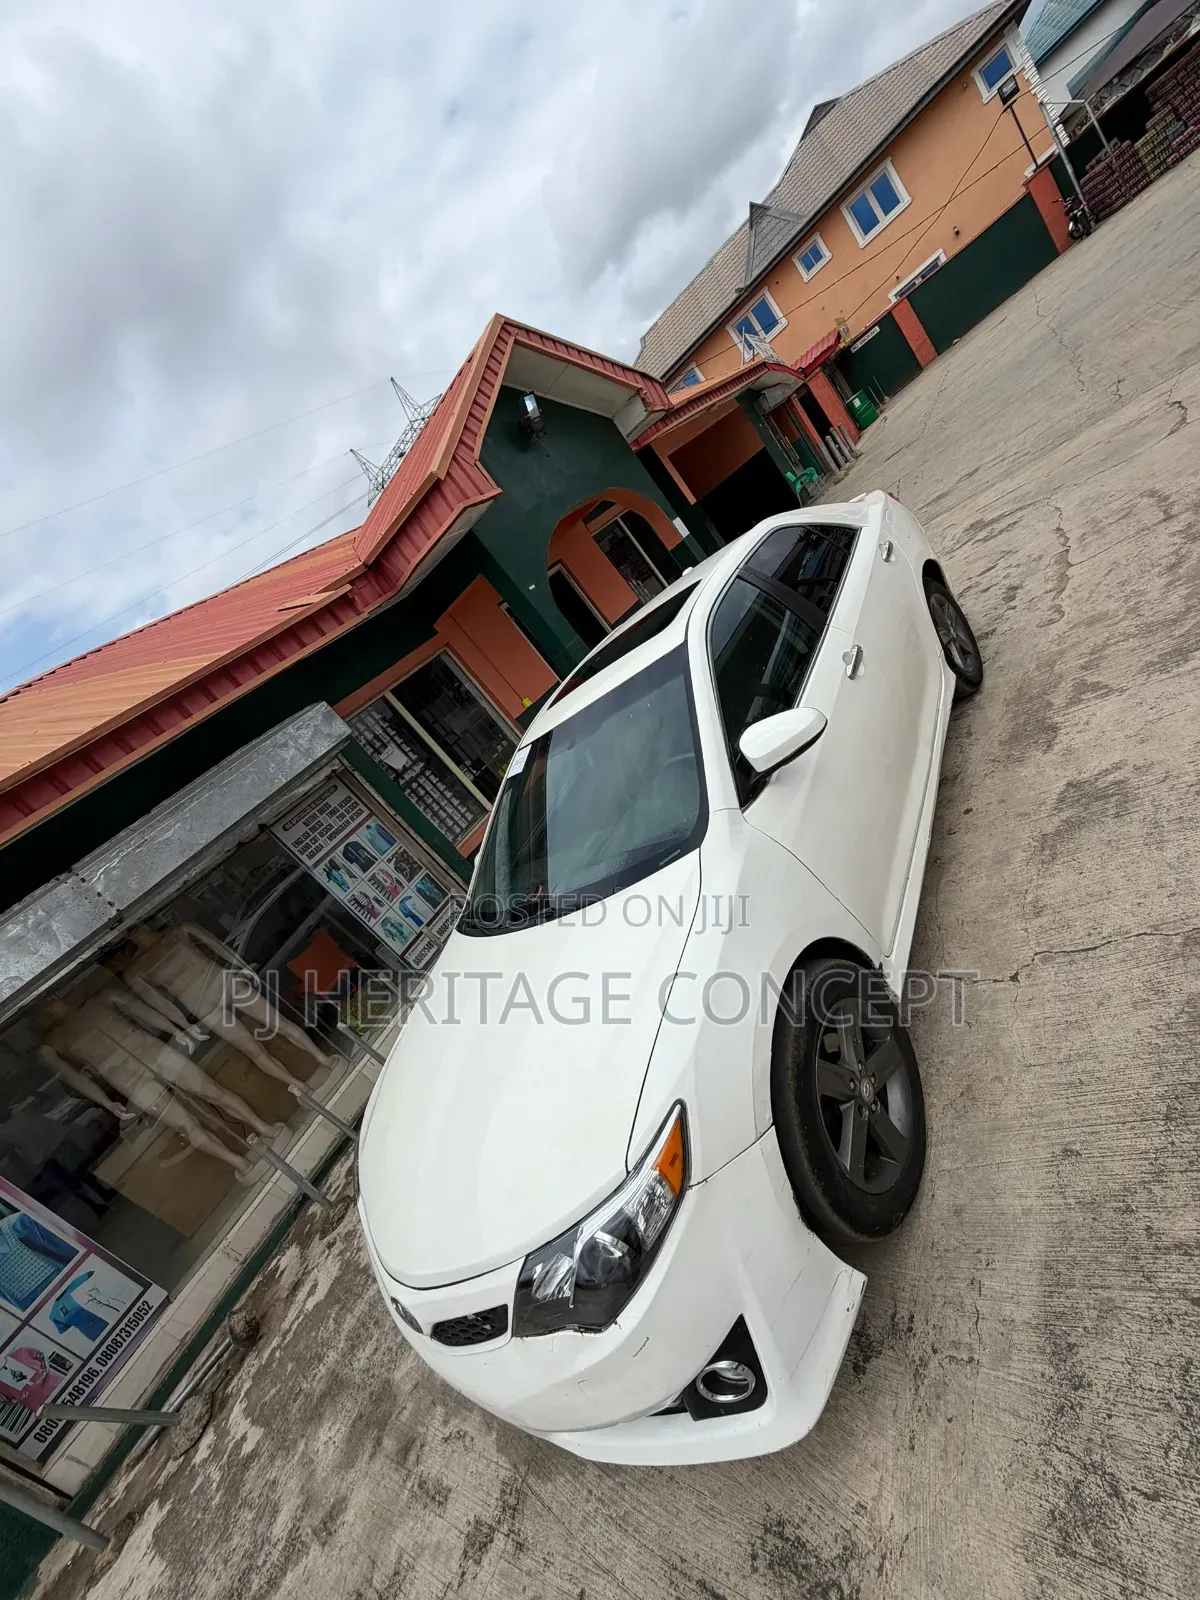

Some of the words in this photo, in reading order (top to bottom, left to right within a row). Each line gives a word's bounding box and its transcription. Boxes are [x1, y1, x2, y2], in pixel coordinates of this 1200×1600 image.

[291, 830, 312, 849] ENGLISH
[308, 820, 325, 835] DRESS
[337, 795, 354, 810] DESIGN
[297, 841, 313, 856] HAND
[309, 834, 320, 846] CUT
[317, 822, 335, 838] DESIGN
[343, 800, 361, 815] DESIGN
[302, 811, 320, 828] NATIVE
[316, 801, 332, 816] DRESS
[326, 818, 353, 842] MONOGRAM
[348, 807, 365, 822] DESIGN
[33, 1366, 104, 1444] 080548196,
[95, 1300, 154, 1368] 08087315052
